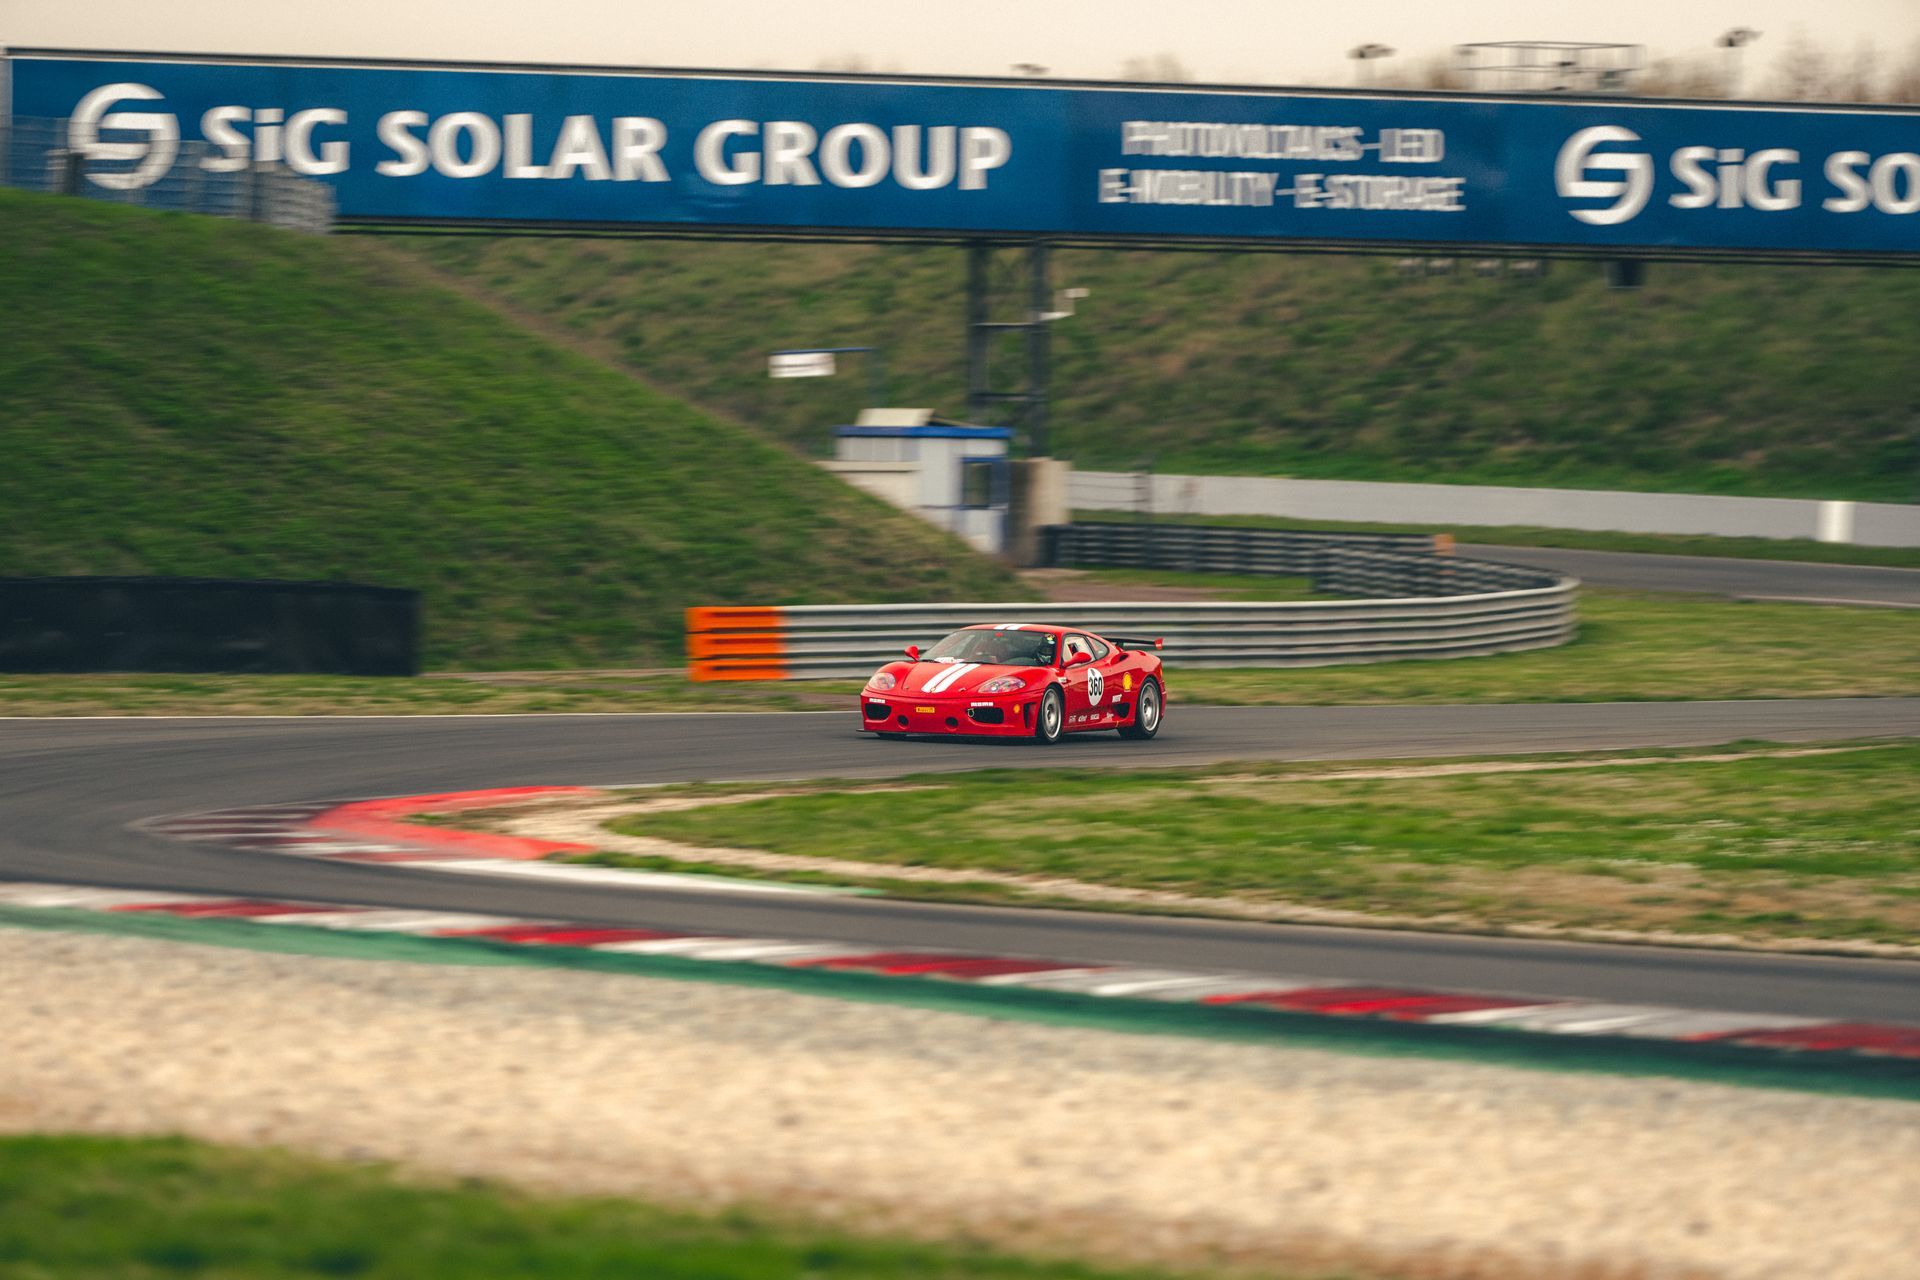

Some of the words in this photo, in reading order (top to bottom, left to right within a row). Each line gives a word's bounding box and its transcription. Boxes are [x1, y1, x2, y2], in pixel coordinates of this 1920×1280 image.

[376, 110, 671, 182] SOLAR
[694, 119, 1012, 191] GROUP
[1089, 676, 1103, 696] 360
